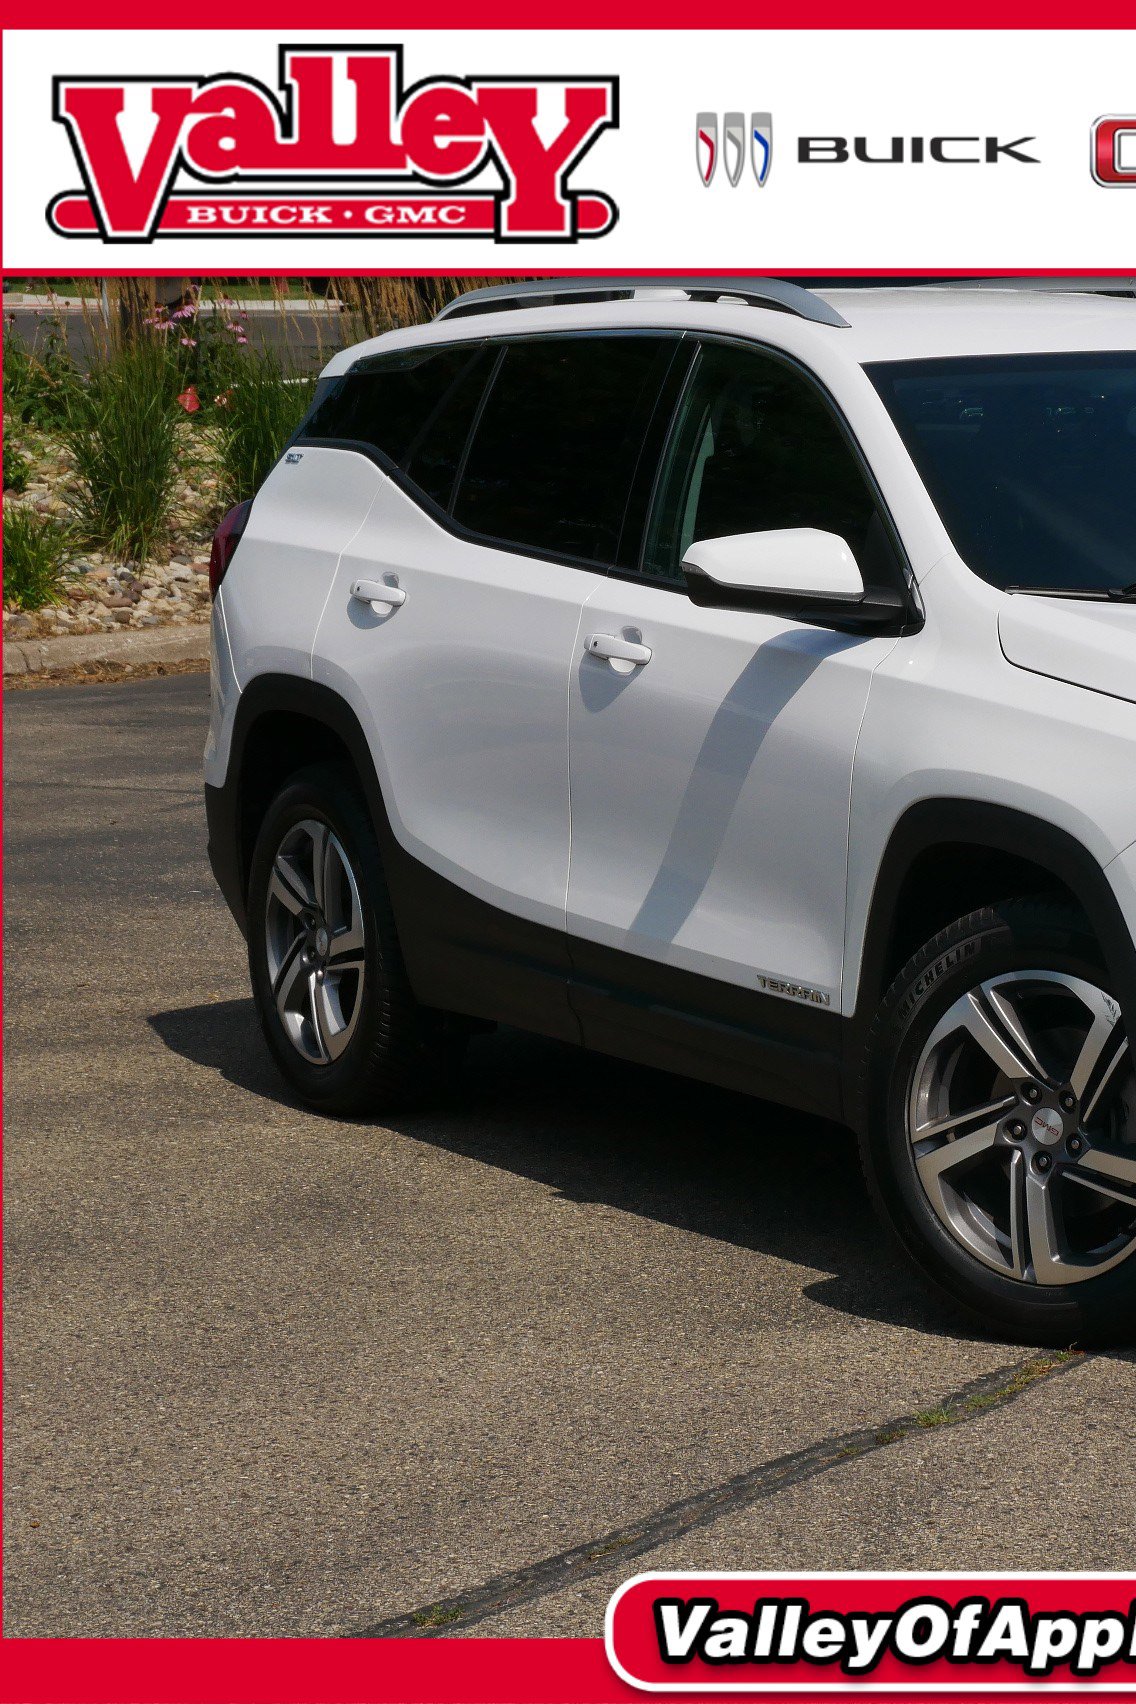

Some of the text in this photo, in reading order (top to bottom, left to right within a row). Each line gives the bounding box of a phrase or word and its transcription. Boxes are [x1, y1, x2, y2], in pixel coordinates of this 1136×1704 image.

[756, 974, 831, 1007] TERRAIN
[900, 940, 977, 1021] MICHELIN
[1034, 1116, 1060, 1137] GMC
